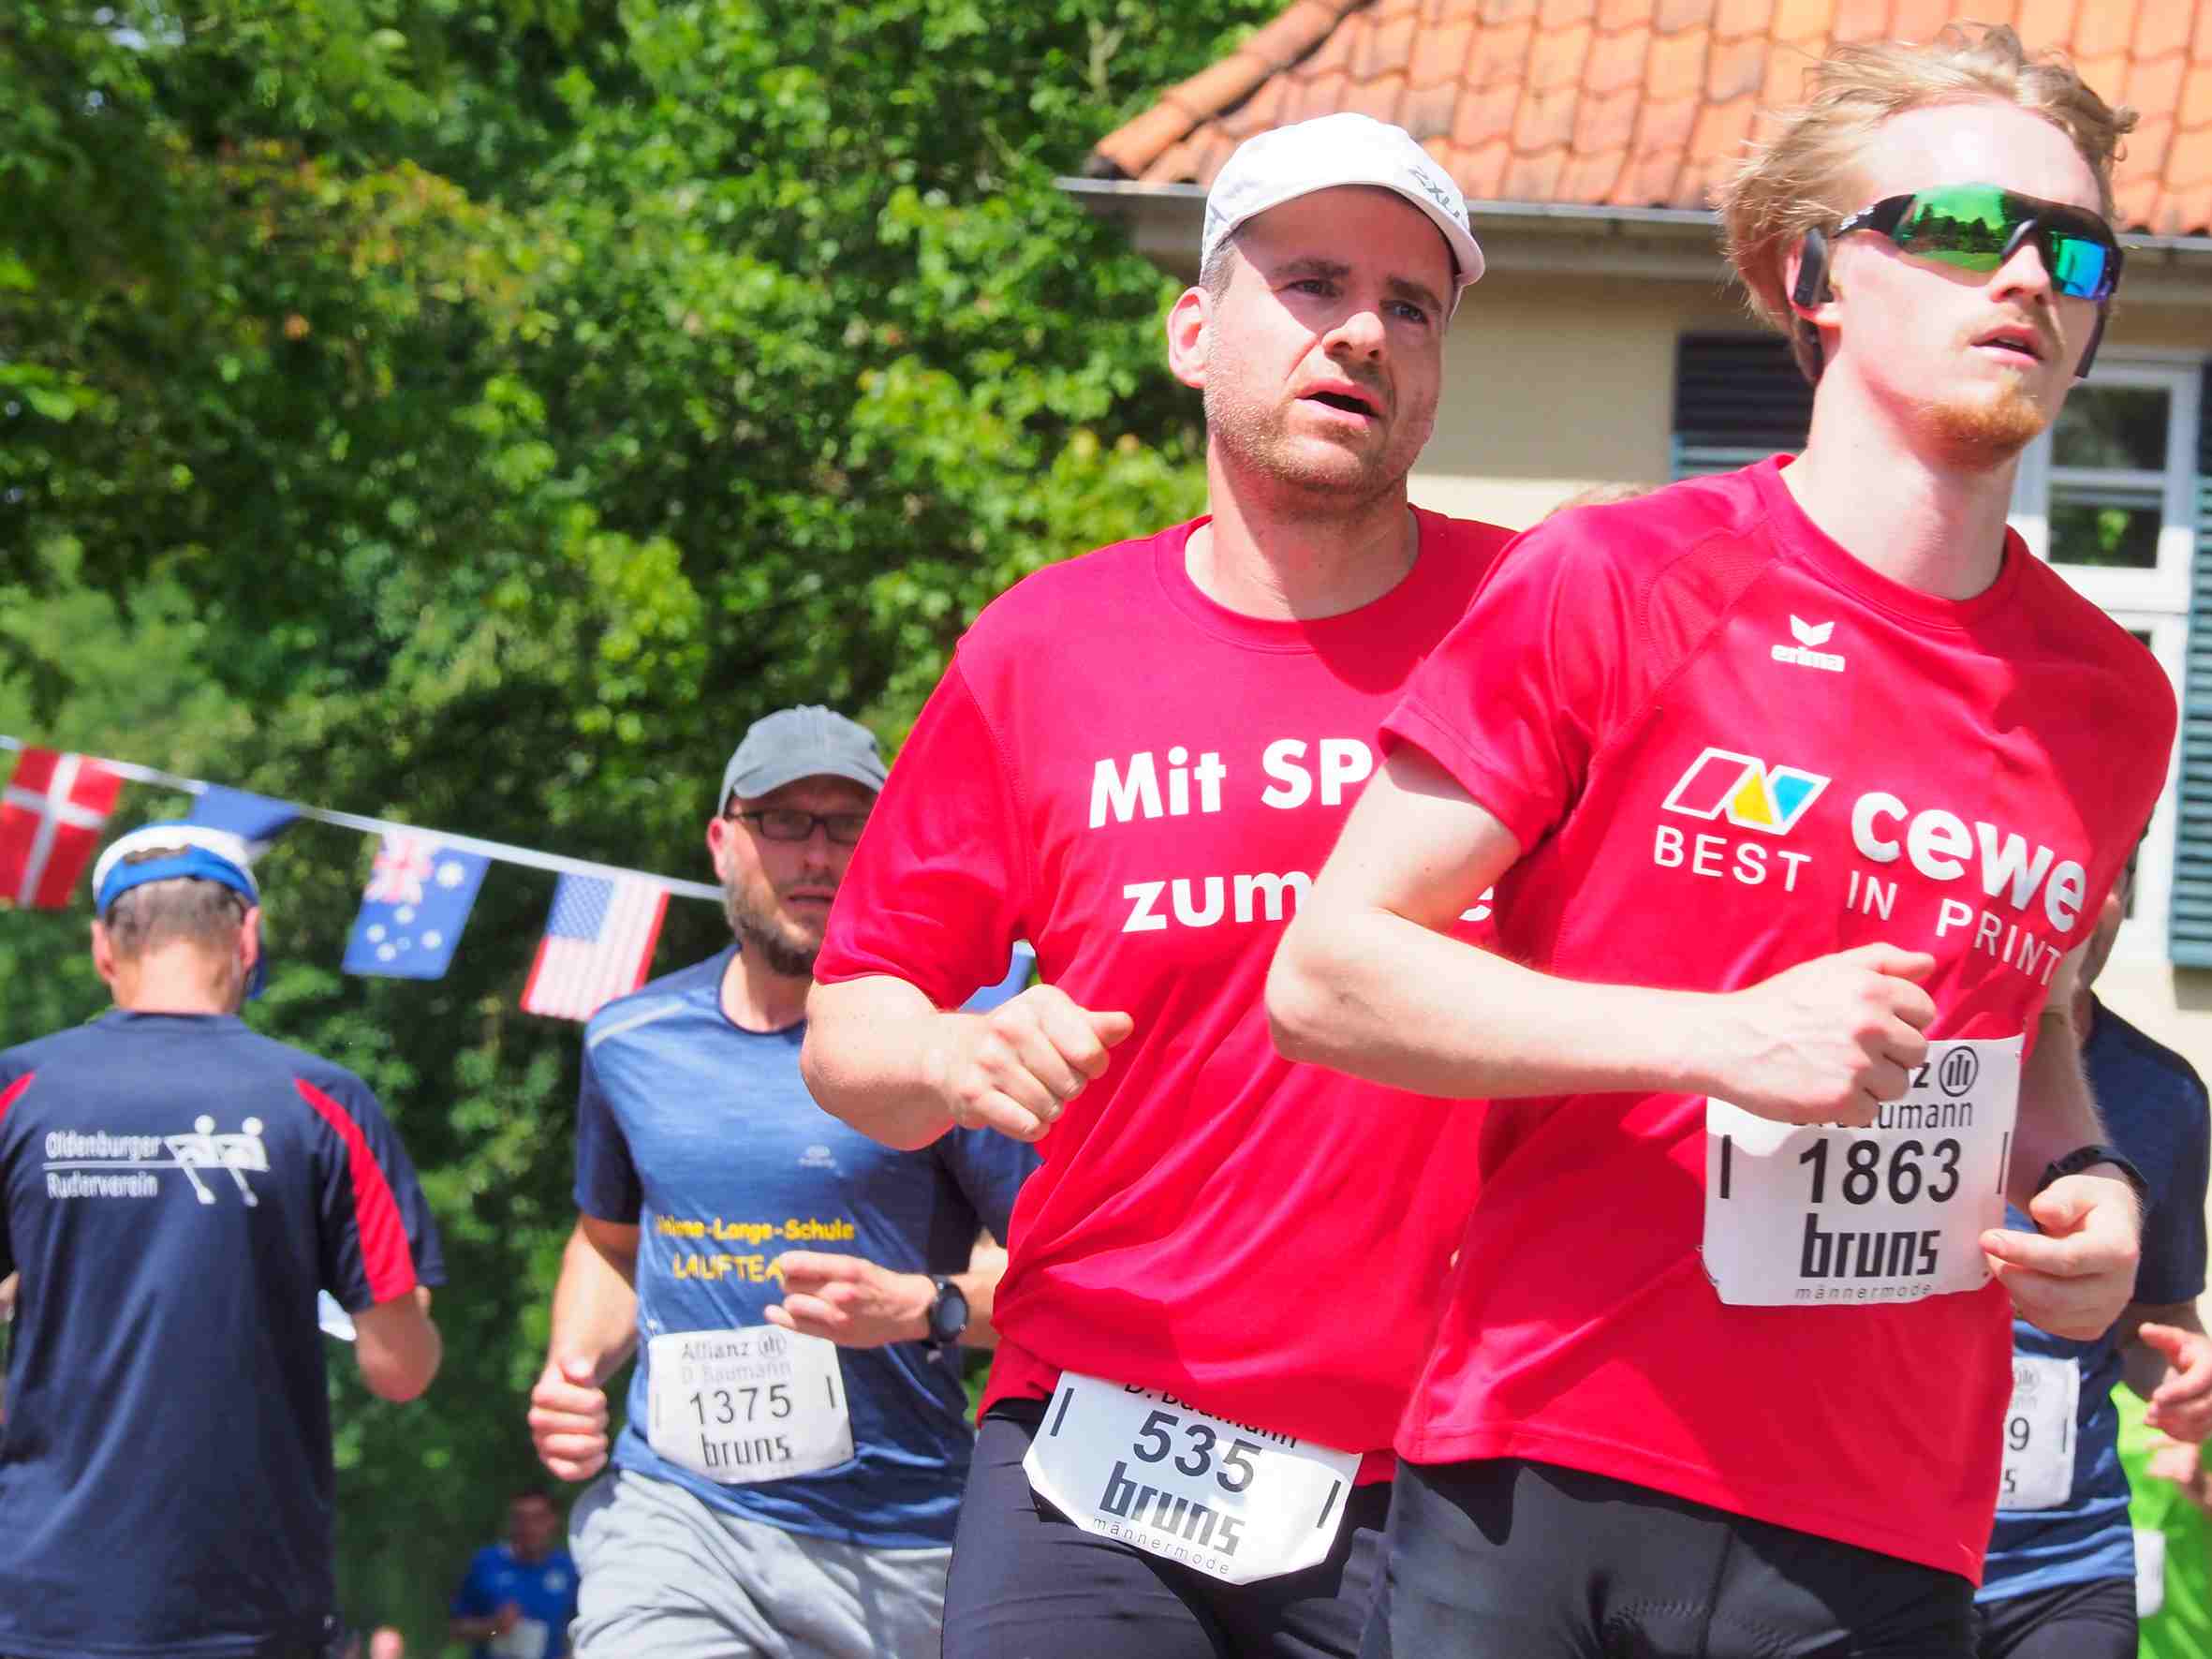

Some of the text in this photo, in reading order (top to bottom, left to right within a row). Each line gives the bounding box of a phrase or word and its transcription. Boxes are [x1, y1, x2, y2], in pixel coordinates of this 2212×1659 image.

[1088, 738, 1374, 828] Mit SP
[1851, 792, 2087, 933] cewe
[1122, 870, 1314, 933] zum
[1653, 824, 2061, 986] BEST IN PRINT
[45, 1130, 161, 1163] Oldenburger
[1799, 1138, 1962, 1205] 1863
[47, 1170, 159, 1199] Ruderverein
[672, 1252, 785, 1283] LAUFTEA
[1799, 1212, 1941, 1278] bruns
[1794, 1281, 1933, 1300] männermode
[682, 1341, 750, 1360] Allianz
[689, 1384, 791, 1425] 1375
[701, 1433, 793, 1468] bruns
[1132, 1409, 1262, 1493] 535
[1099, 1460, 1246, 1557] bruns
[1093, 1515, 1230, 1576] männermode
